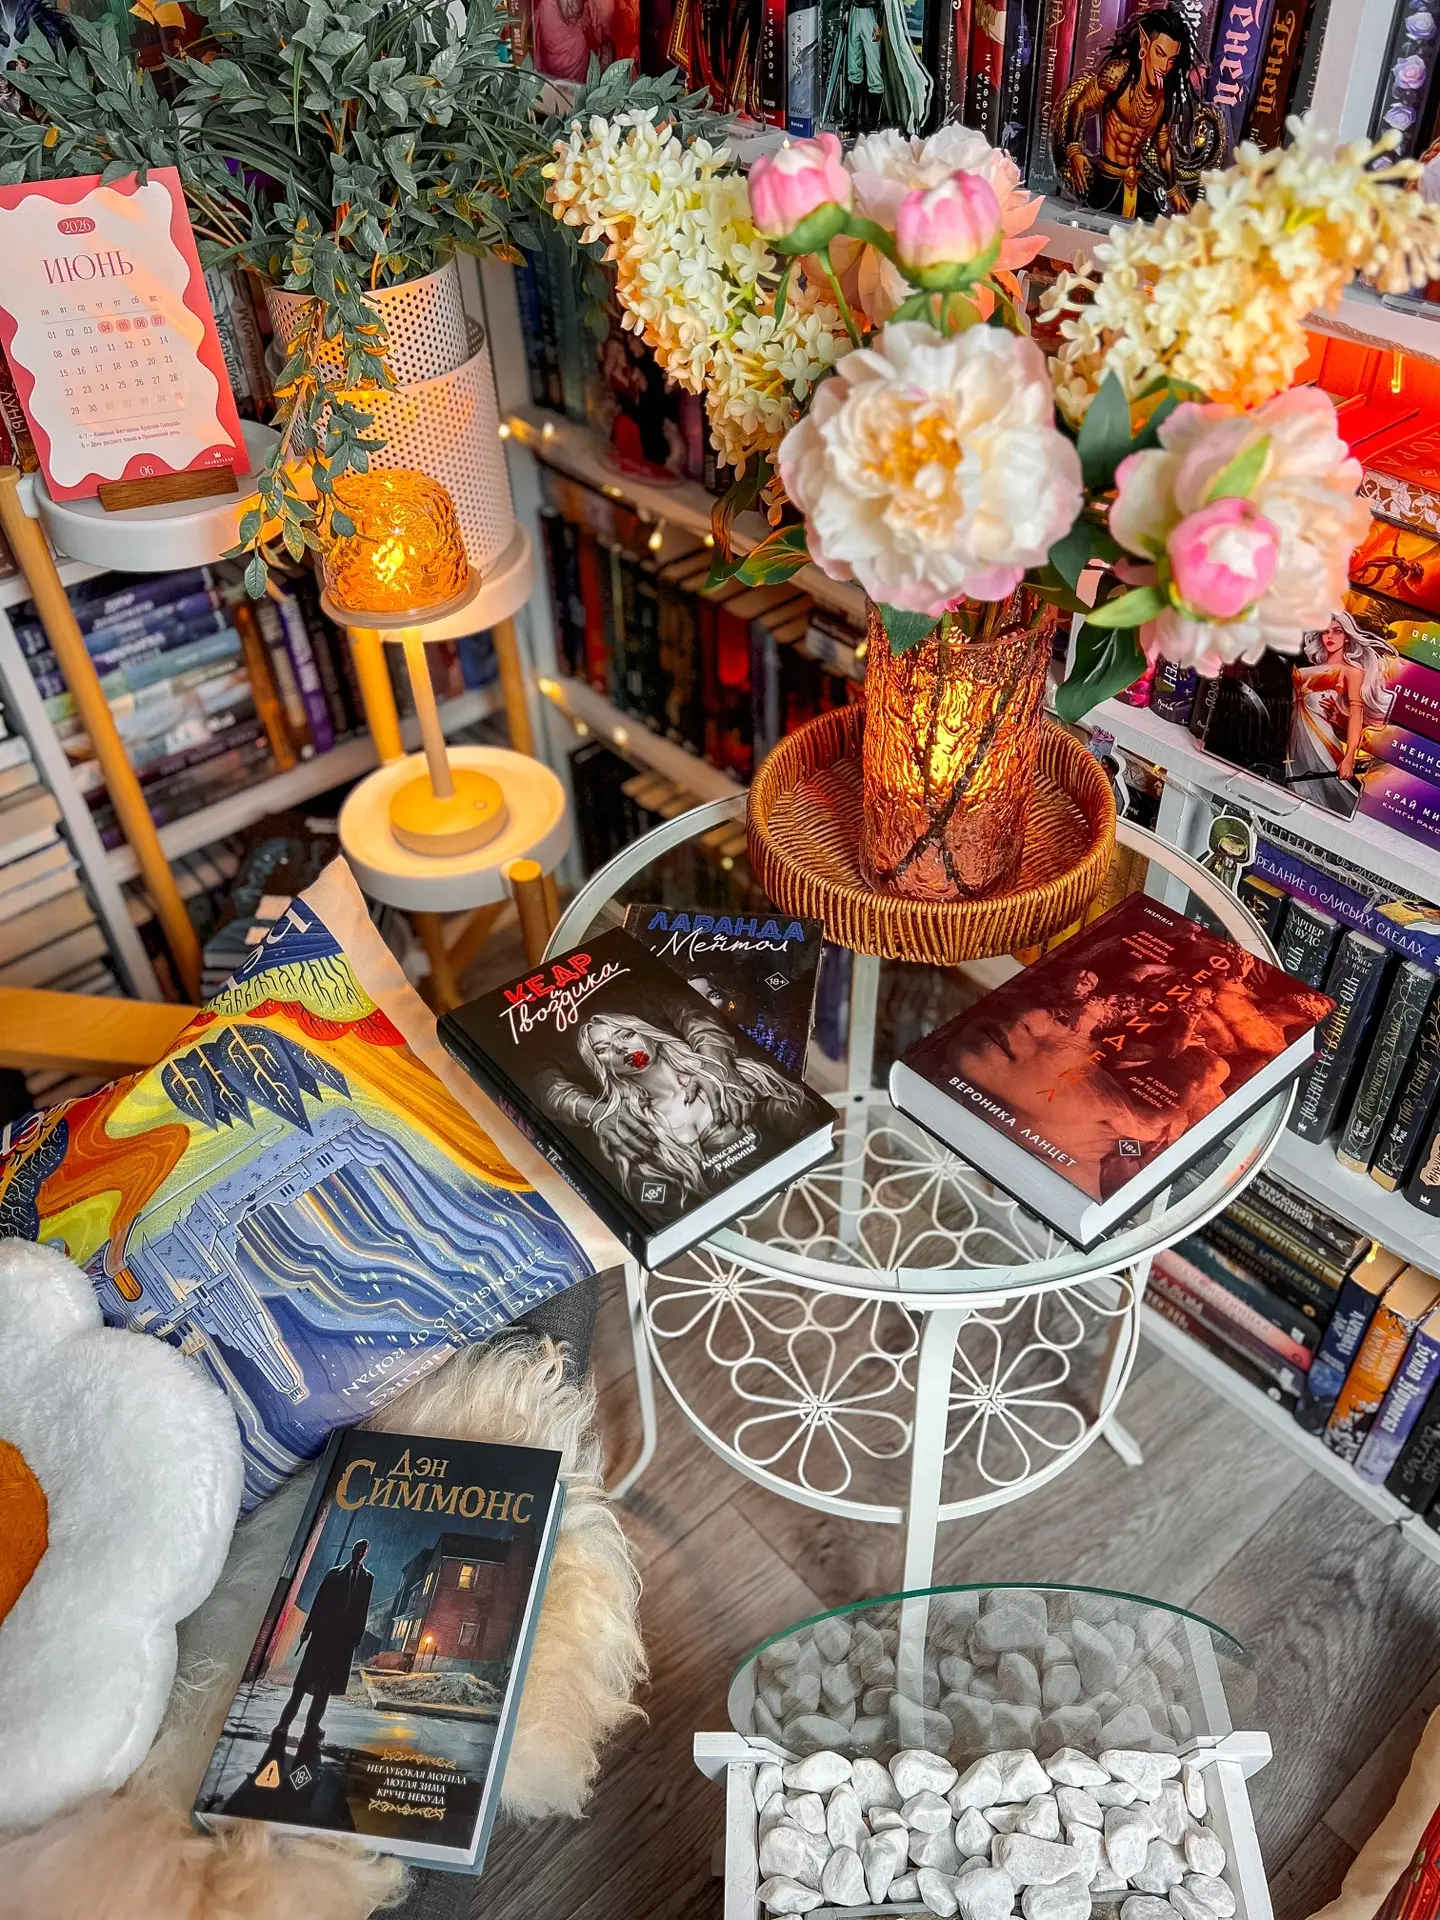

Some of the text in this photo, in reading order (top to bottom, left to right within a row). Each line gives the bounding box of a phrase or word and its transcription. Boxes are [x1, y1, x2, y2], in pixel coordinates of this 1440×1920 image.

[944, 24, 955, 101] ХОФФМАН
[1008, 55, 1016, 93] РИТА
[1012, 35, 1025, 115] ХОФФМАН
[975, 72, 983, 110] РИТА
[980, 53, 992, 131] ХОФФМАН
[62, 219, 91, 234] 2026
[41, 250, 134, 285] ИЮНЬ
[47, 317, 162, 339] 01 02 03 04 05 06 07
[53, 336, 169, 359] 08 09 10 11 12 13 14
[60, 355, 174, 378] 15 16 17 18 19 20 21
[65, 373, 179, 397] 22 23 24 25 26 27 28
[71, 391, 184, 415] 29 30 01 02 03 04 05
[139, 464, 154, 477] 06
[1411, 629, 1440, 650] ОБЛ
[1394, 684, 1440, 711] ПУЧИН
[1405, 704, 1440, 723] КНИГИ
[1384, 789, 1440, 823] КРАЙ МИ
[648, 911, 805, 942] ЛАВАНДА
[1143, 908, 1174, 926] INSPIRIA
[1308, 884, 1318, 897] О
[1319, 892, 1374, 929] ЛИСЬИХ
[1376, 923, 1426, 958] СЛЕДАХ
[650, 928, 789, 961] Ментол
[1284, 946, 1305, 972] ЧТО
[503, 952, 593, 1008] КЕДР
[769, 976, 786, 988] 18+
[1339, 976, 1361, 1002] ЧТО
[1317, 1048, 1335, 1067] ЗА
[1129, 1076, 1180, 1109] ДЛЯ ТЕБЯ СТАНУ
[1153, 1080, 1179, 1098] ТОЛЬКО
[1300, 1066, 1329, 1126] ЗАВЕСОЙ
[1357, 1051, 1391, 1120] ПРОРОЧЕСТВО
[1398, 1051, 1432, 1126] ПИР ТЕНЕЙ
[948, 1076, 1078, 1168] ВЕРОНИКА ЛАНЦЕТ
[702, 1131, 757, 1170] Александра
[715, 1144, 758, 1174] Рябкина
[645, 1185, 664, 1200] 18+
[1257, 1187, 1314, 1230] ВАМПИРОВ
[389, 1448, 449, 1479] Дэн
[336, 1458, 536, 1524] Симмонс
[366, 1764, 467, 1785] НЕГЛУБОКАЯ МОГИЛА
[383, 1779, 446, 1794] ЛЮТАЯ ЗИМА
[376, 1788, 445, 1805] КРУЧЕ НЕКУДА
